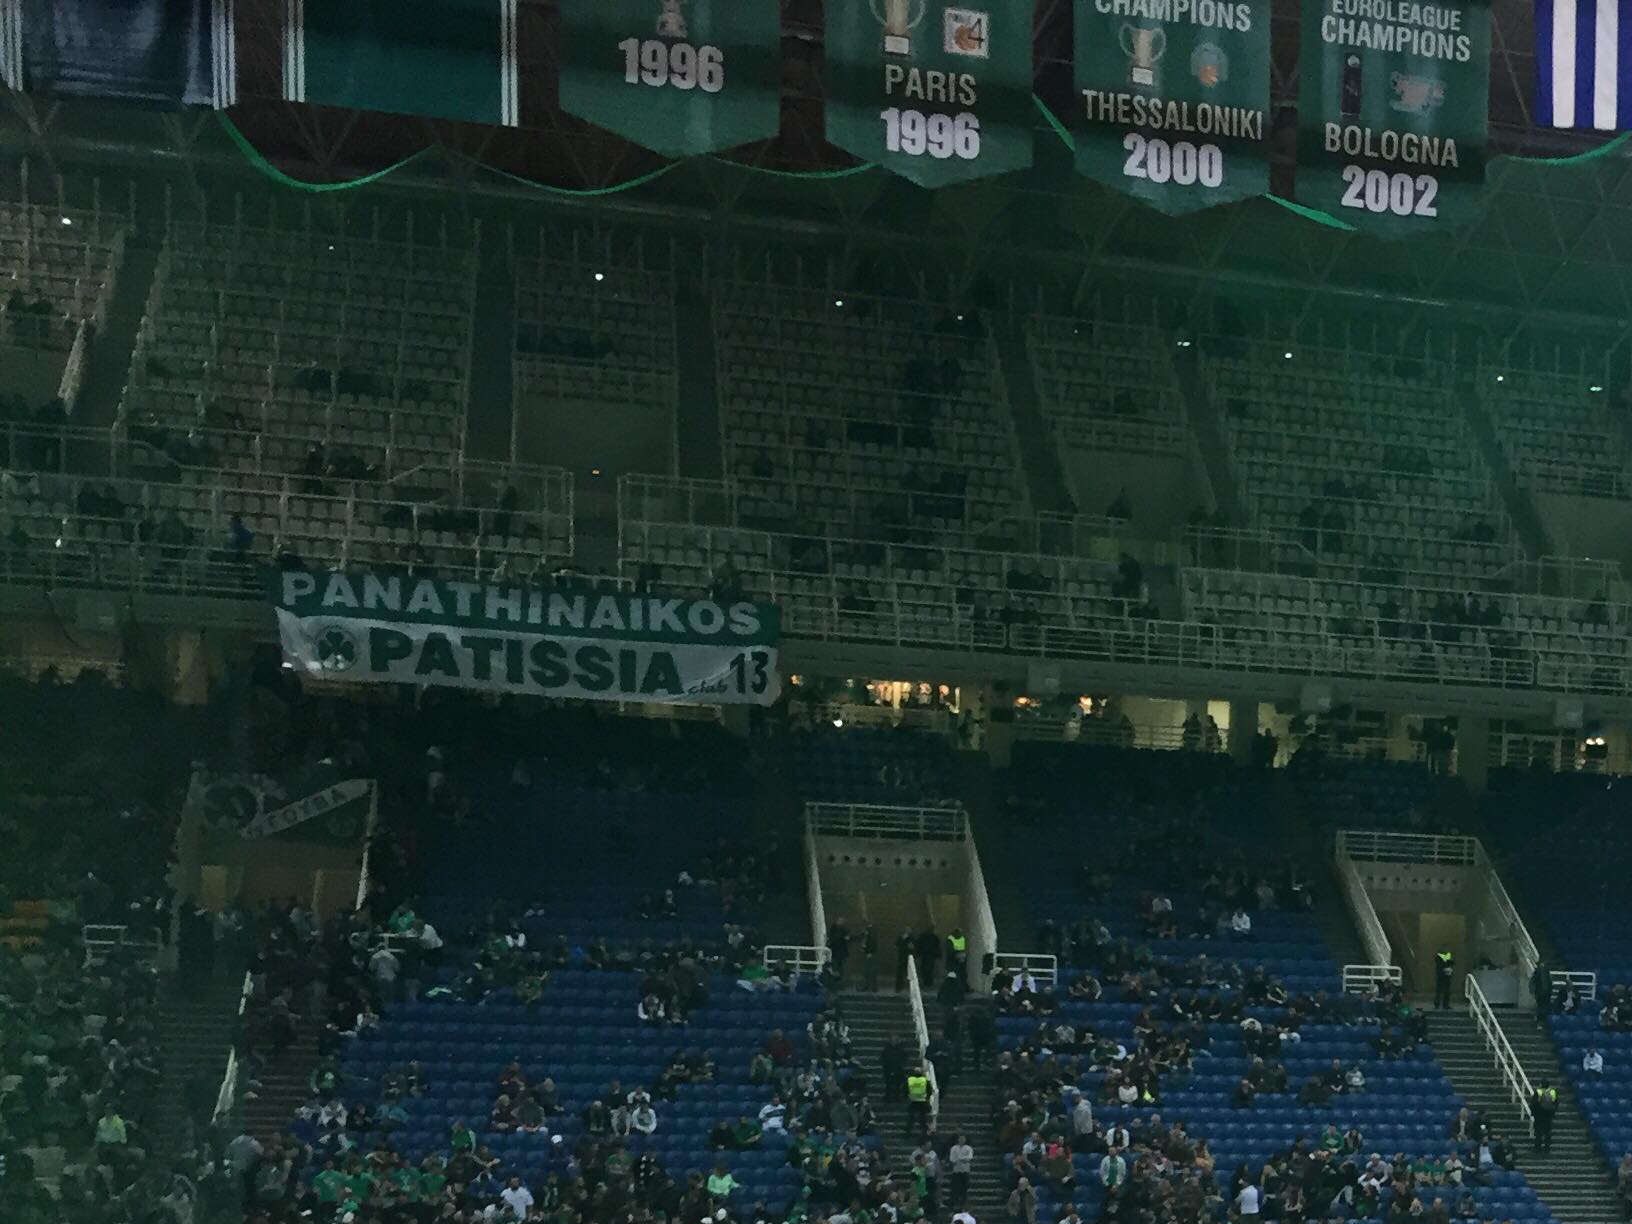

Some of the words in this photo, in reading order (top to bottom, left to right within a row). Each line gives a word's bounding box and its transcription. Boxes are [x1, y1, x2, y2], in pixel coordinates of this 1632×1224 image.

[1095, 0, 1252, 32] CHAMPIONS
[1321, 15, 1471, 62] CHAMPIONS
[1331, 0, 1462, 32] EUROLEAGUE
[617, 37, 724, 92] 1996
[885, 64, 977, 106] PARIS
[881, 107, 980, 160] 1996
[1082, 89, 1263, 140] THESSALONIKI
[1123, 133, 1224, 188] 2000
[1324, 123, 1459, 168] BOLOGNA
[1340, 165, 1439, 217] 2002
[281, 571, 762, 636] PANATHINAIKOS
[369, 626, 684, 696] PATISSIA
[730, 650, 770, 694] 13
